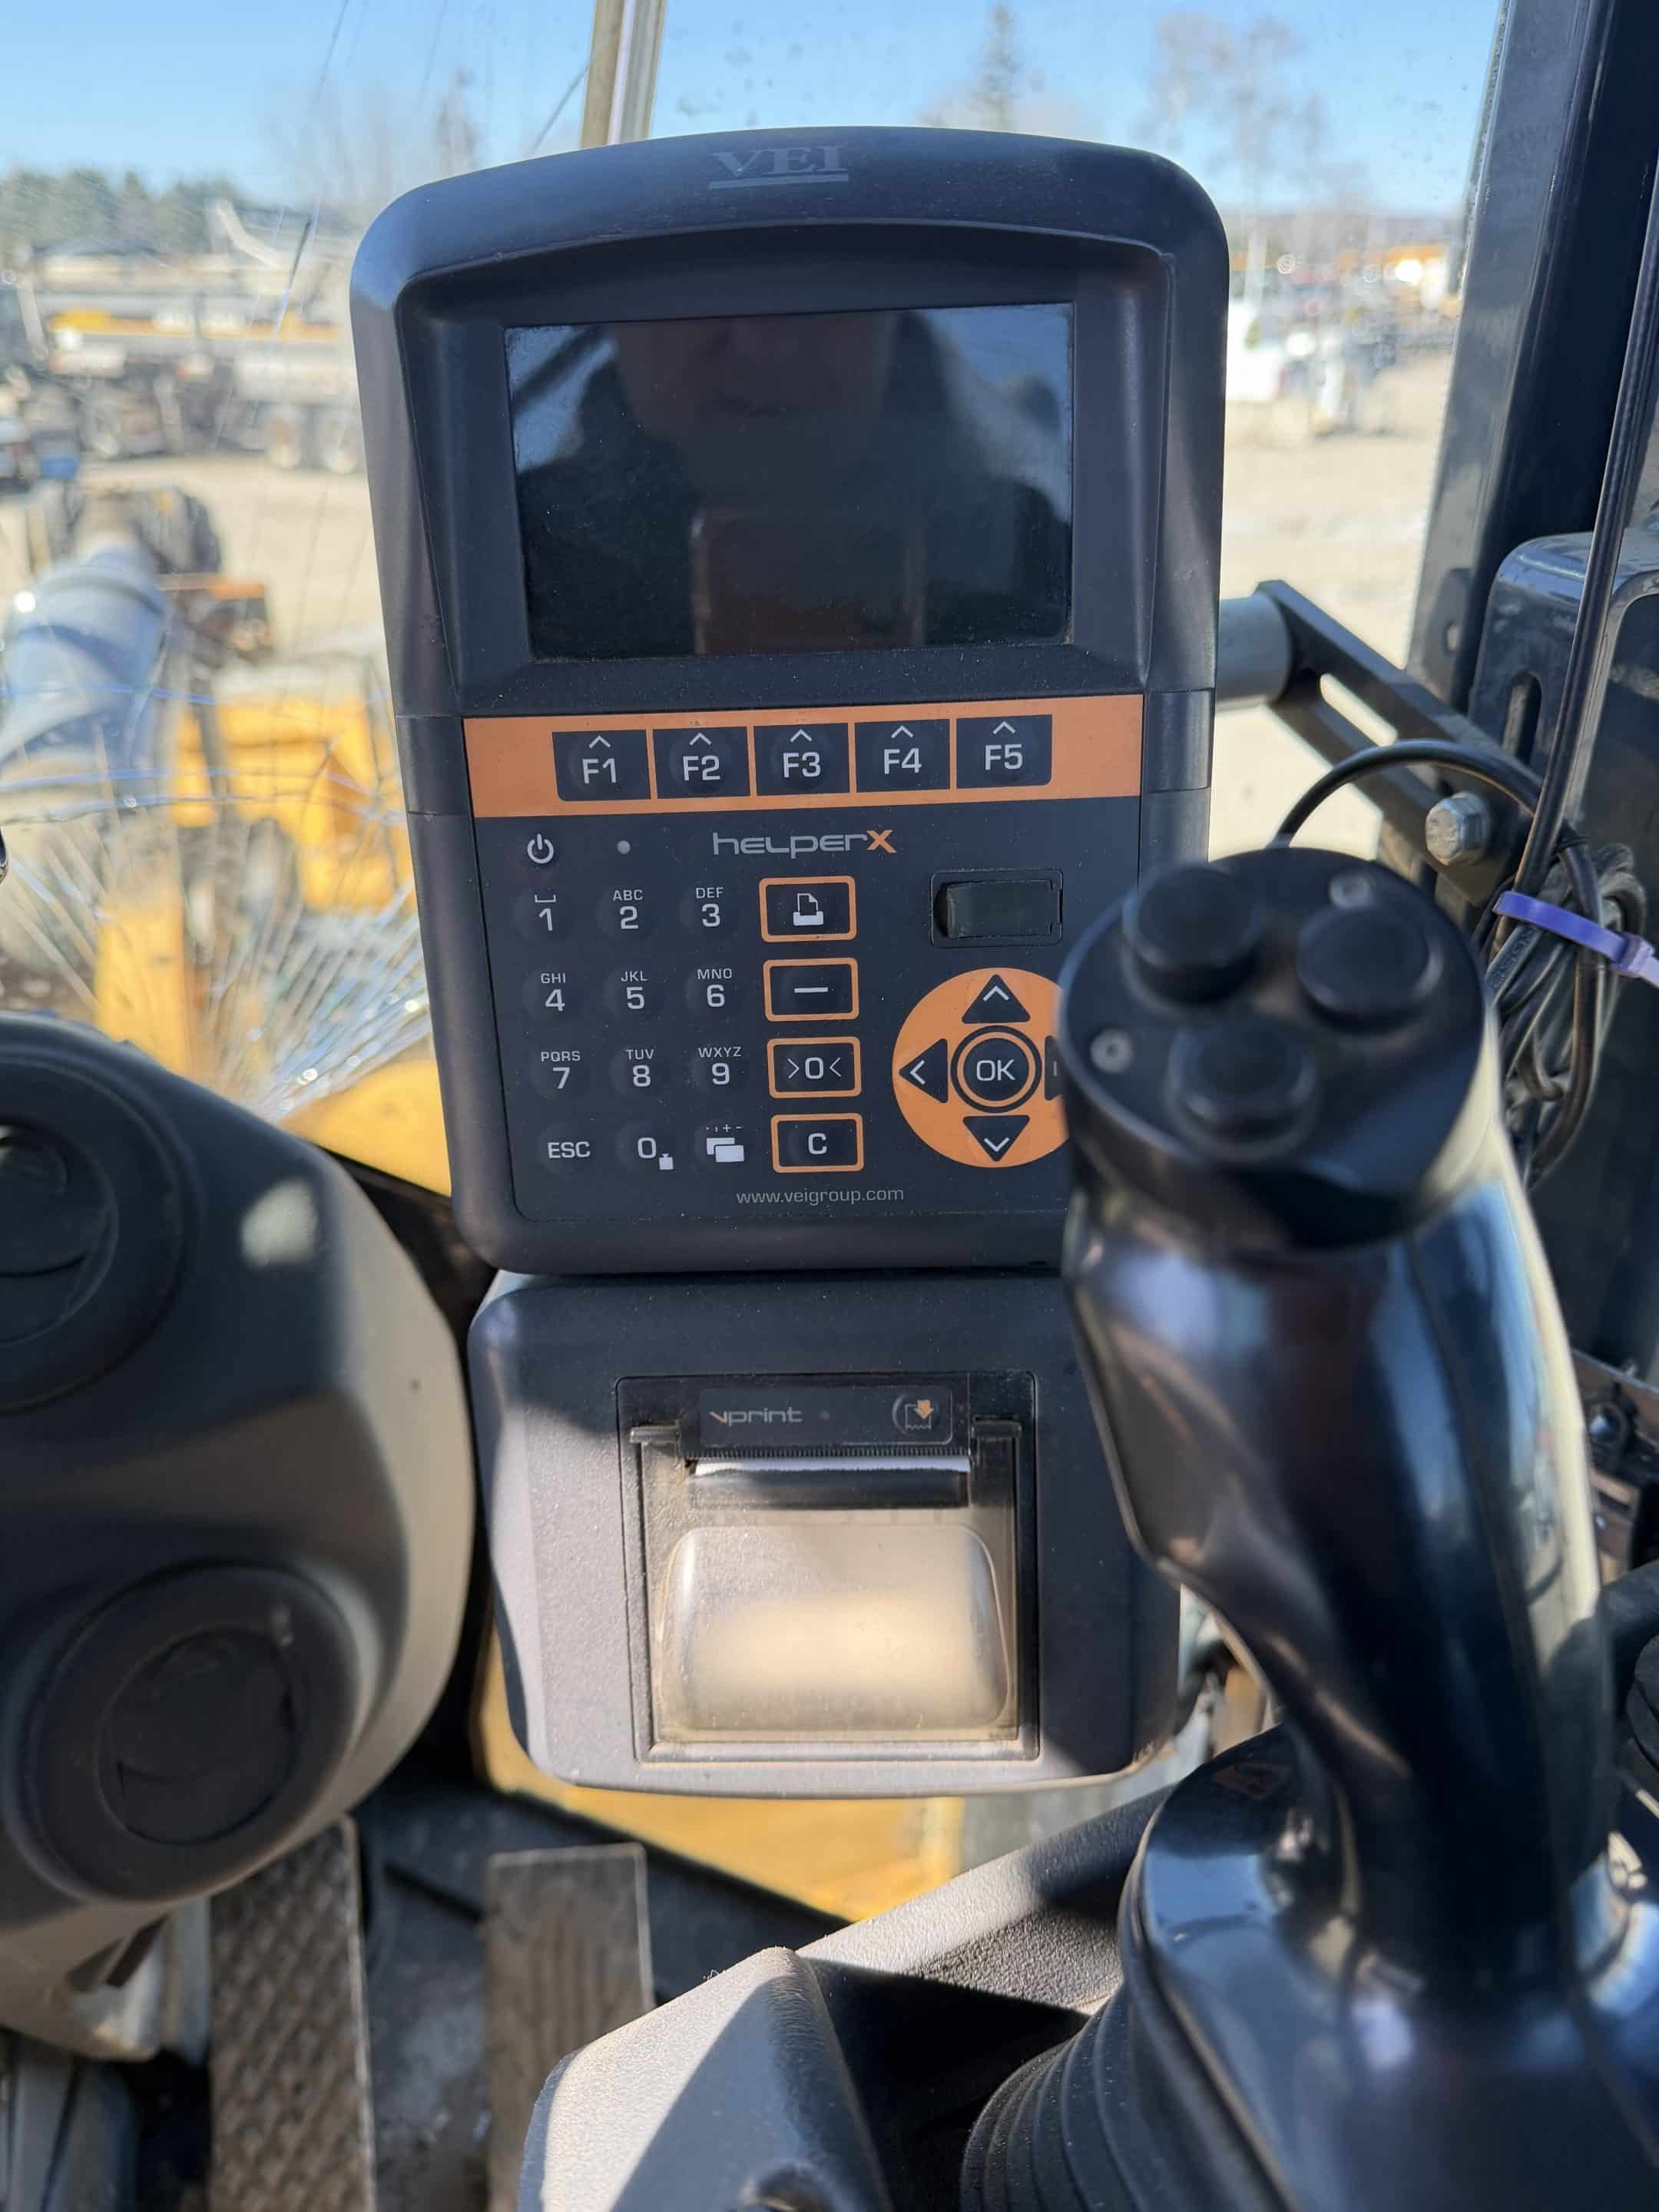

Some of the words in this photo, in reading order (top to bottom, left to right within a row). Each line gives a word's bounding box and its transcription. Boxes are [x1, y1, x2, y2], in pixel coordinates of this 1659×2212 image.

[711, 146, 848, 177] VEI
[783, 750, 821, 778] F3
[883, 747, 922, 774] F4
[985, 743, 1023, 770] F5
[582, 758, 617, 784] F1
[682, 756, 720, 781] F2
[613, 889, 644, 901] ABC
[696, 887, 724, 899] DEF
[538, 908, 553, 931] 1
[619, 906, 639, 929] 2
[701, 903, 720, 927] 3
[540, 972, 566, 984] GHI
[621, 970, 648, 982] JKL
[697, 968, 733, 980] MNO
[545, 988, 565, 1012] 4
[626, 986, 645, 1010] 5
[707, 984, 726, 1008] 6
[541, 1051, 581, 1062] PQRS
[626, 1048, 654, 1060] TUV
[698, 1046, 743, 1058] WXYZ
[552, 1067, 571, 1089] 7
[632, 1065, 651, 1088] 8
[711, 1063, 730, 1085] 9
[975, 1058, 1015, 1082] OK
[547, 1141, 591, 1159] ESC
[808, 1133, 827, 1155] C
[736, 1187, 905, 1206] www.veigroup.com
